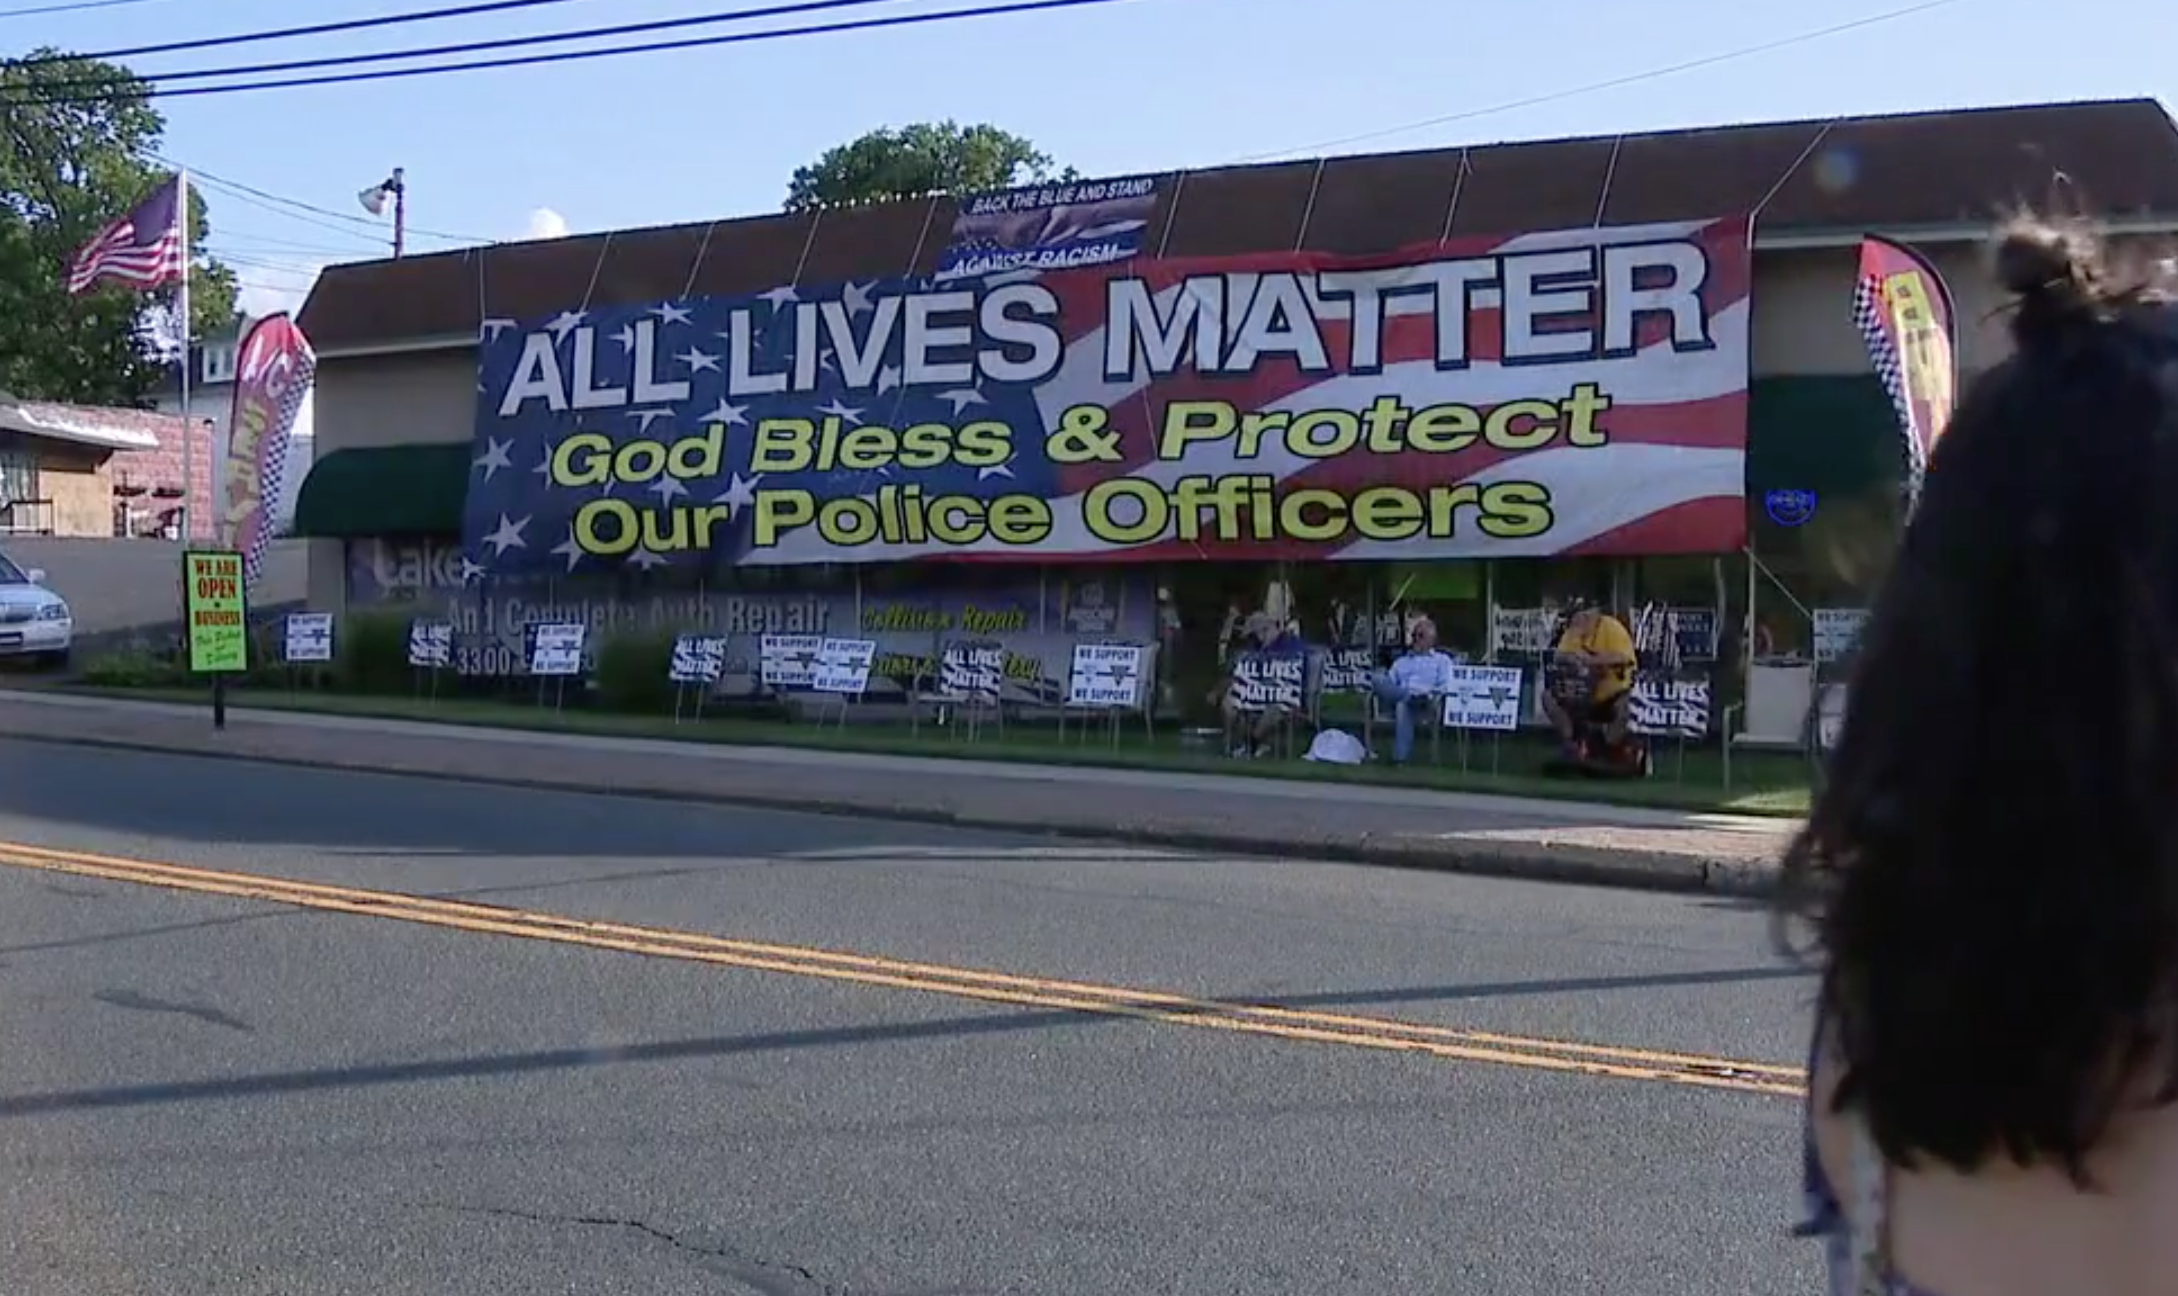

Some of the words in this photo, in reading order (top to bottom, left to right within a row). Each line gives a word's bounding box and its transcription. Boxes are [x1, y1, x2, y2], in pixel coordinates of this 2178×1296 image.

[971, 196, 1011, 214] BACK
[1012, 191, 1037, 209] THE
[1038, 187, 1075, 206] BLUE
[1075, 184, 1107, 202] AND
[1107, 178, 1154, 199] STAND
[950, 250, 1033, 276] AGAINST
[1037, 243, 1120, 269] RACISM
[499, 316, 693, 418] ALL
[728, 283, 1062, 398] LIVES
[1102, 240, 1716, 384] MATTER
[550, 421, 726, 488] God
[749, 415, 1013, 474] Bless
[1045, 404, 1124, 464] &
[1156, 382, 1614, 462] Protect
[572, 497, 731, 557] Our
[751, 482, 1053, 549] Police
[1080, 473, 1556, 545] Officers
[194, 559, 211, 576] WE
[215, 559, 238, 576] ARE
[197, 577, 236, 599] OPEN
[194, 610, 241, 626] BUSINESS
[727, 597, 829, 634] Repair
[765, 638, 778, 649] WE
[780, 638, 819, 649] SUPPORT
[826, 641, 838, 652] WE
[838, 642, 872, 653] SUPPORT
[457, 646, 511, 676] 3300
[968, 650, 1001, 667] LIVES
[1079, 649, 1093, 662] WE
[1094, 650, 1135, 662] SUPPORT
[1339, 651, 1371, 668] LIVES
[1234, 661, 1259, 678] ALL
[1262, 660, 1302, 678] LIVES
[1453, 669, 1467, 680] WE
[1468, 669, 1517, 682] SUPPORT
[816, 677, 829, 688] WE
[829, 678, 863, 689] SUPPORT
[1664, 680, 1709, 699] LIVES
[1075, 689, 1089, 700] WE
[1091, 689, 1132, 701] SUPPORT
[1238, 685, 1299, 703] MATTER
[1450, 711, 1465, 723] WE
[1466, 712, 1512, 725] SUPPORT
[1635, 704, 1702, 725] MATTER
